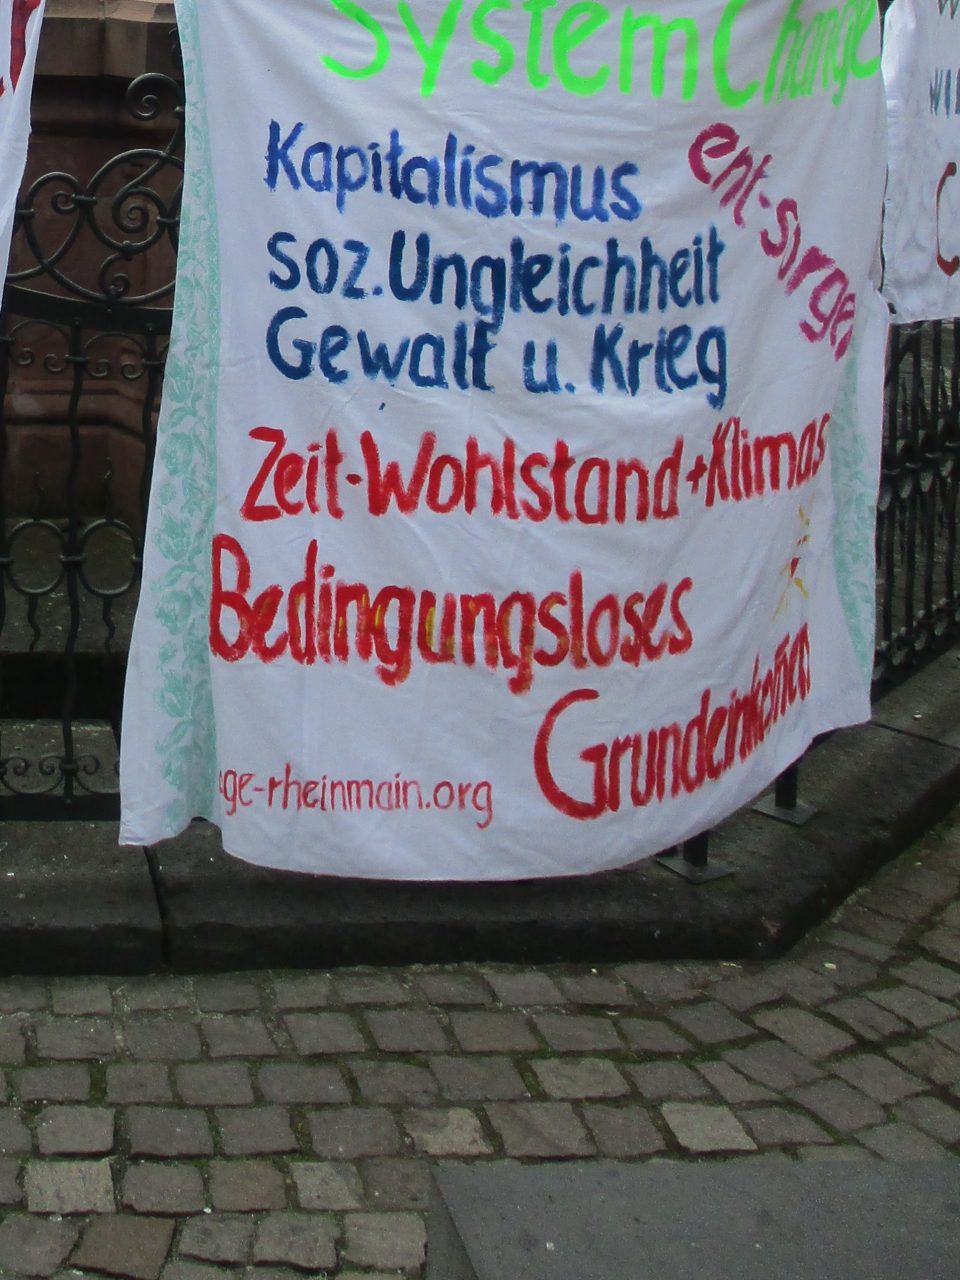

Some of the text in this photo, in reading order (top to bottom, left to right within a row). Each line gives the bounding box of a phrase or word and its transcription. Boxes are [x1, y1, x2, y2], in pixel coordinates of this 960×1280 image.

[264, 120, 644, 226] Kapitalismus
[265, 306, 728, 411] Gewalt u. Krieg
[208, 532, 693, 695] Bedingungsloses
